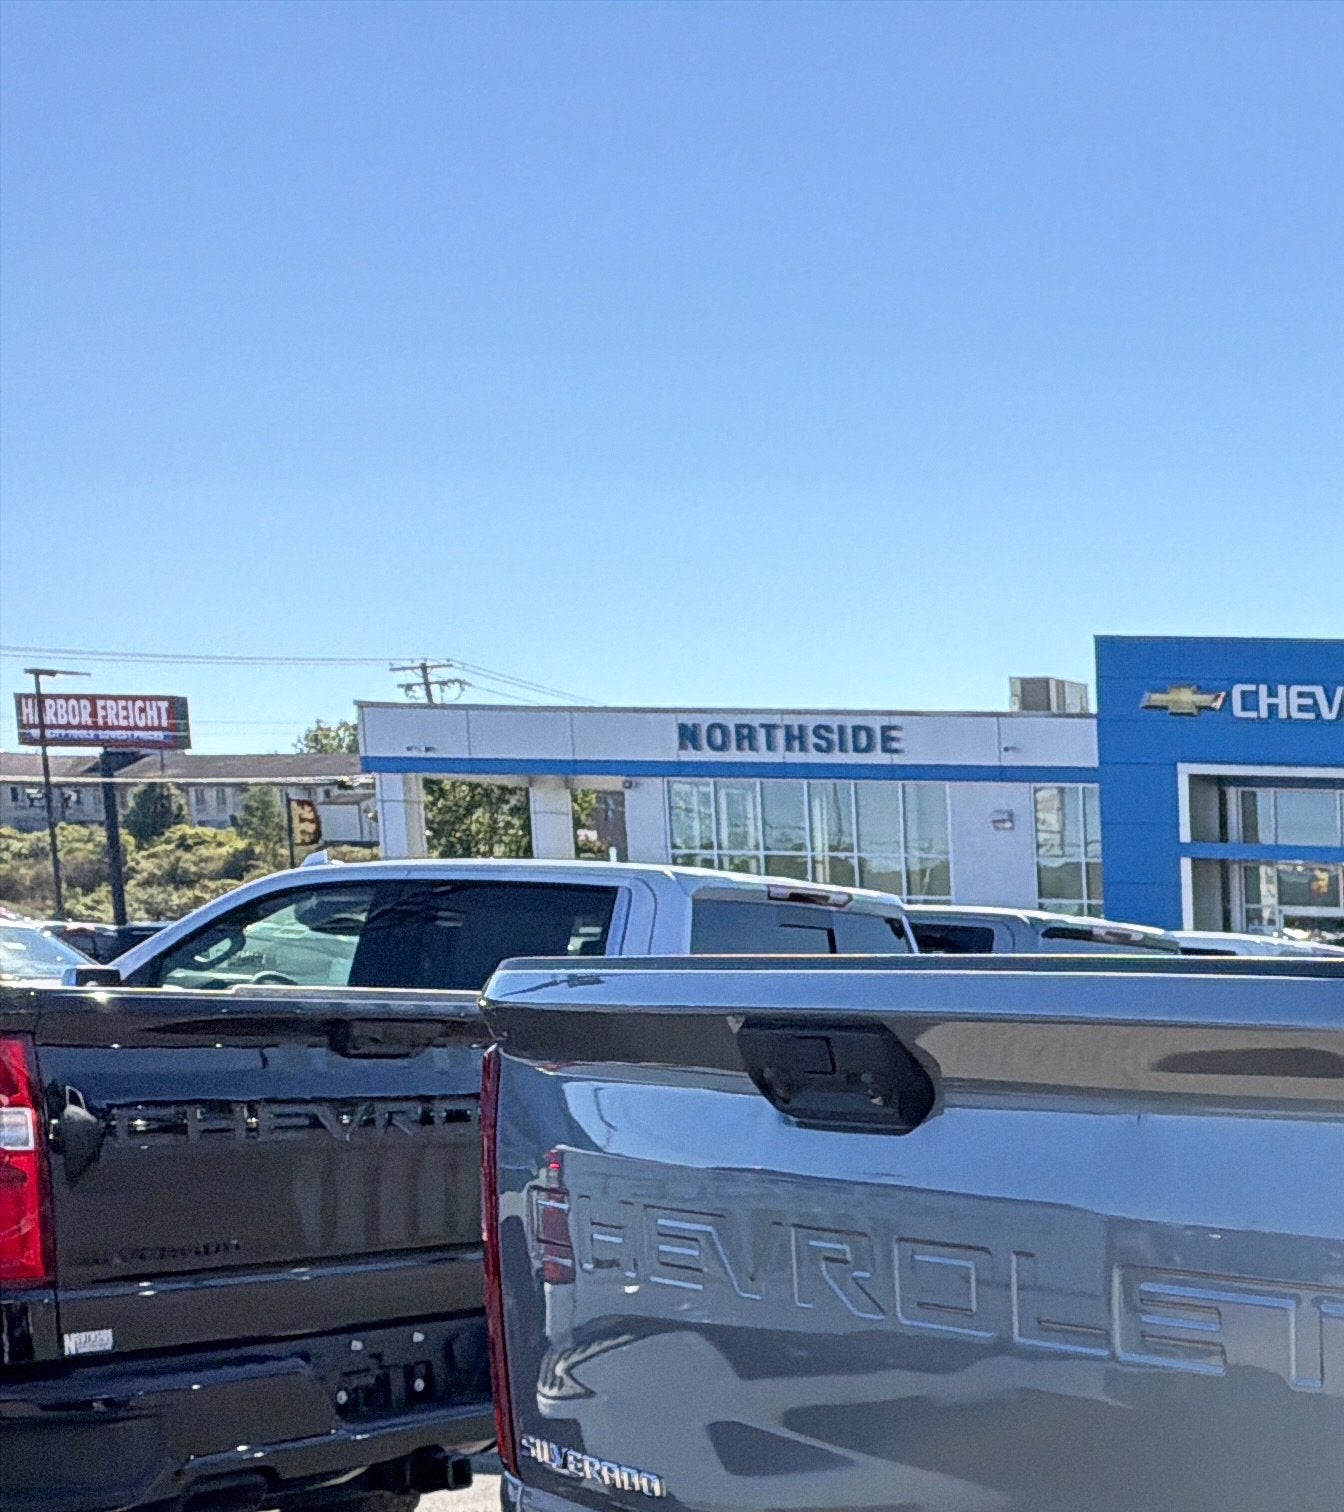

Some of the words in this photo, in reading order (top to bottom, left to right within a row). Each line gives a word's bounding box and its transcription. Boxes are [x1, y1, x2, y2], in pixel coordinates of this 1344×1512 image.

[96, 699, 170, 728] FREIGHT
[677, 722, 904, 754] NORTHSIDE
[112, 1100, 482, 1145] CHEVRO
[520, 1433, 667, 1497] SILVERADO
